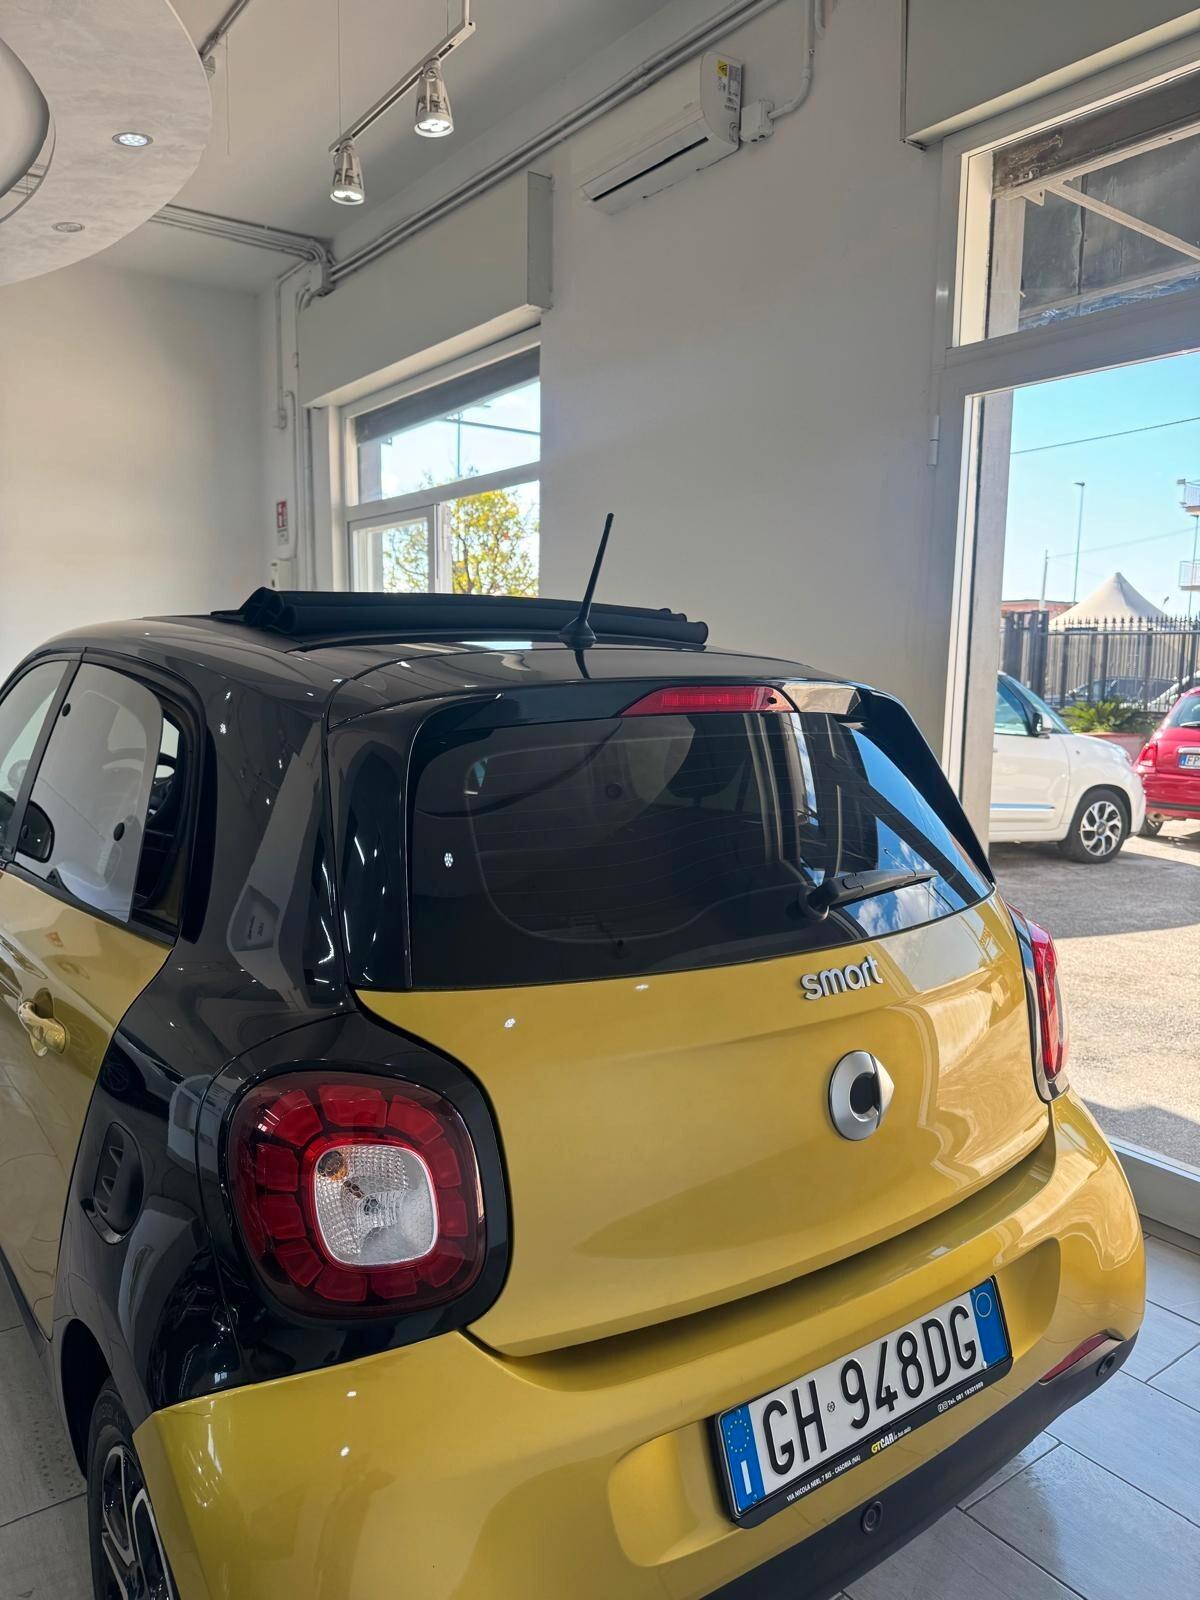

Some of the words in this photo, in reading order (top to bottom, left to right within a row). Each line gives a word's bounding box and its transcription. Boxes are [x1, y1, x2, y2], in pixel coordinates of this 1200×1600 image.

[801, 955, 883, 1000] smart
[762, 1379, 828, 1475] GH
[840, 1305, 977, 1430] 948DG
[795, 1484, 810, 1497] NICOLA
[835, 1460, 851, 1473] CASORIA
